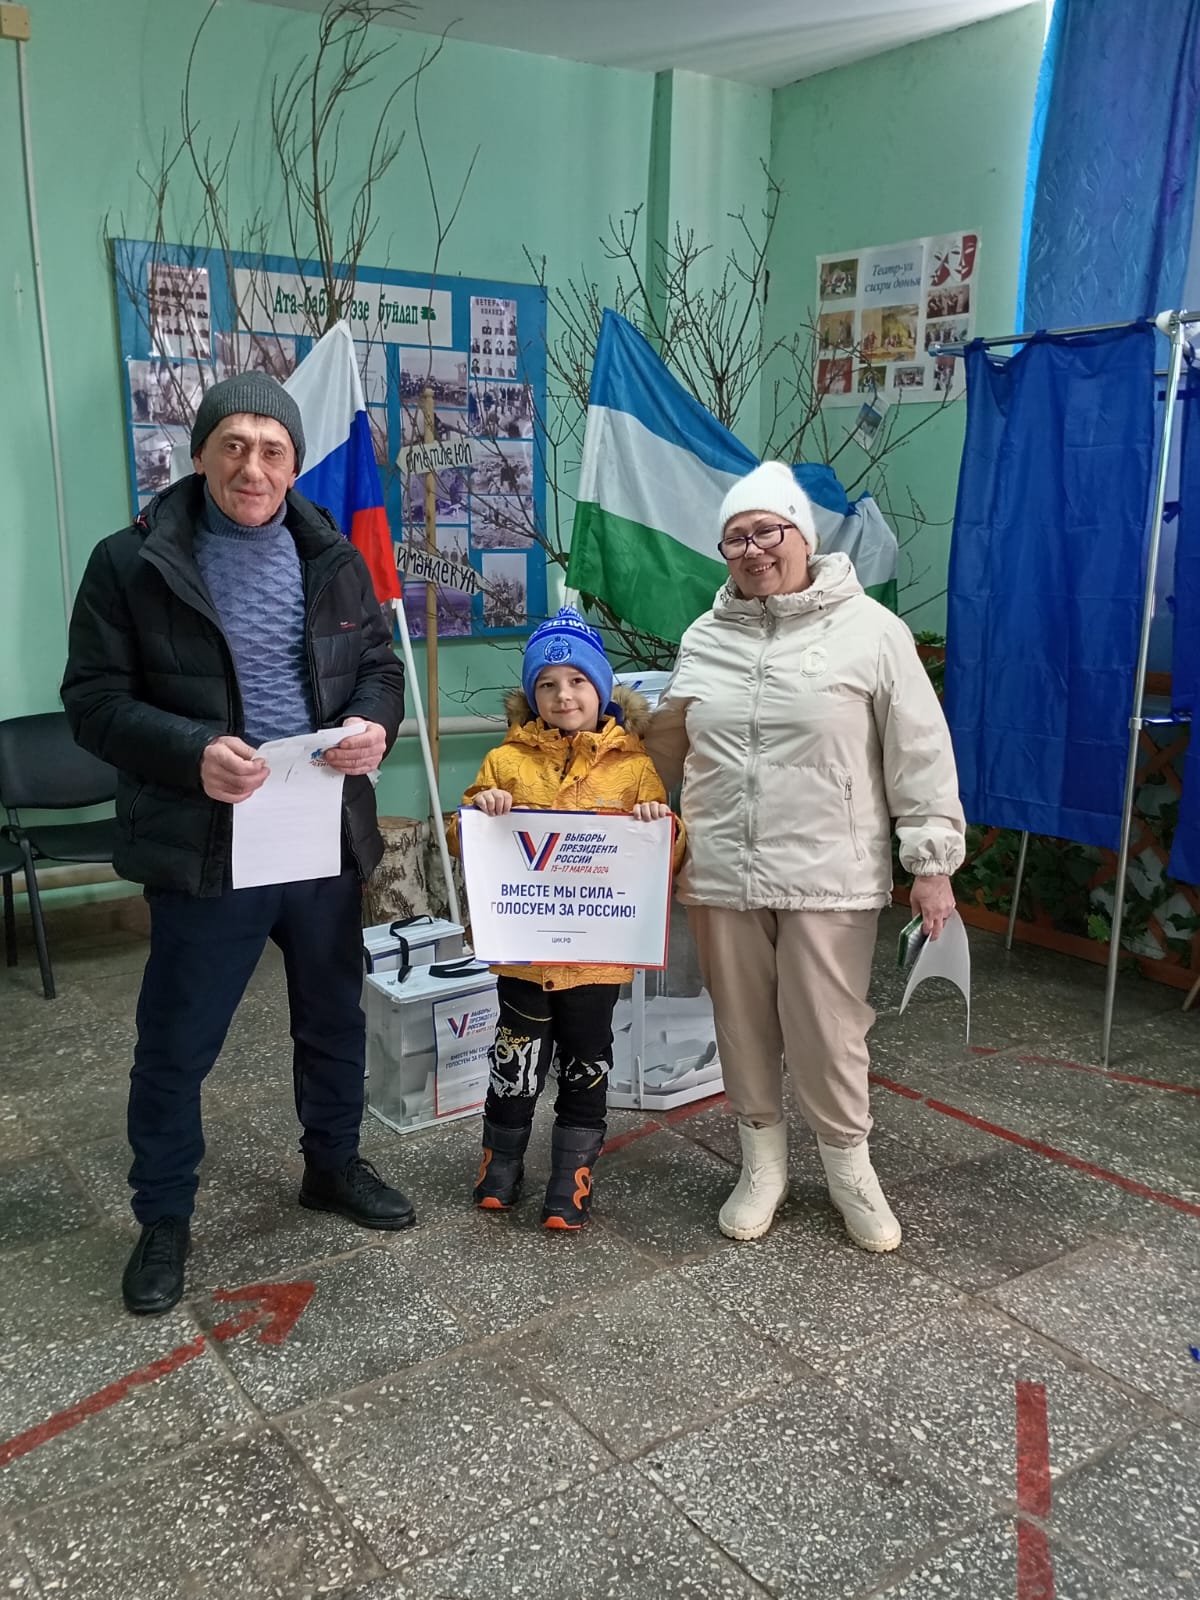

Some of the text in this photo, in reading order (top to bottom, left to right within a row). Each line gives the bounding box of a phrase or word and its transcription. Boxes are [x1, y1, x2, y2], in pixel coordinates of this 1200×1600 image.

[378, 293, 419, 330] буйлап
[564, 833, 607, 843] ВЫБОРЫ
[559, 844, 618, 854] ПРЕЗИДЕНТА
[554, 854, 593, 864] РОССИИ
[570, 865, 593, 873] МАРТА
[593, 866, 609, 874] 2024
[501, 884, 550, 898] ВМЕСТЕ
[554, 886, 576, 898] МЫ
[580, 886, 614, 899] СИЛА
[491, 902, 636, 918] ГОЛОСУЕМ ЗА РОССИЮ!
